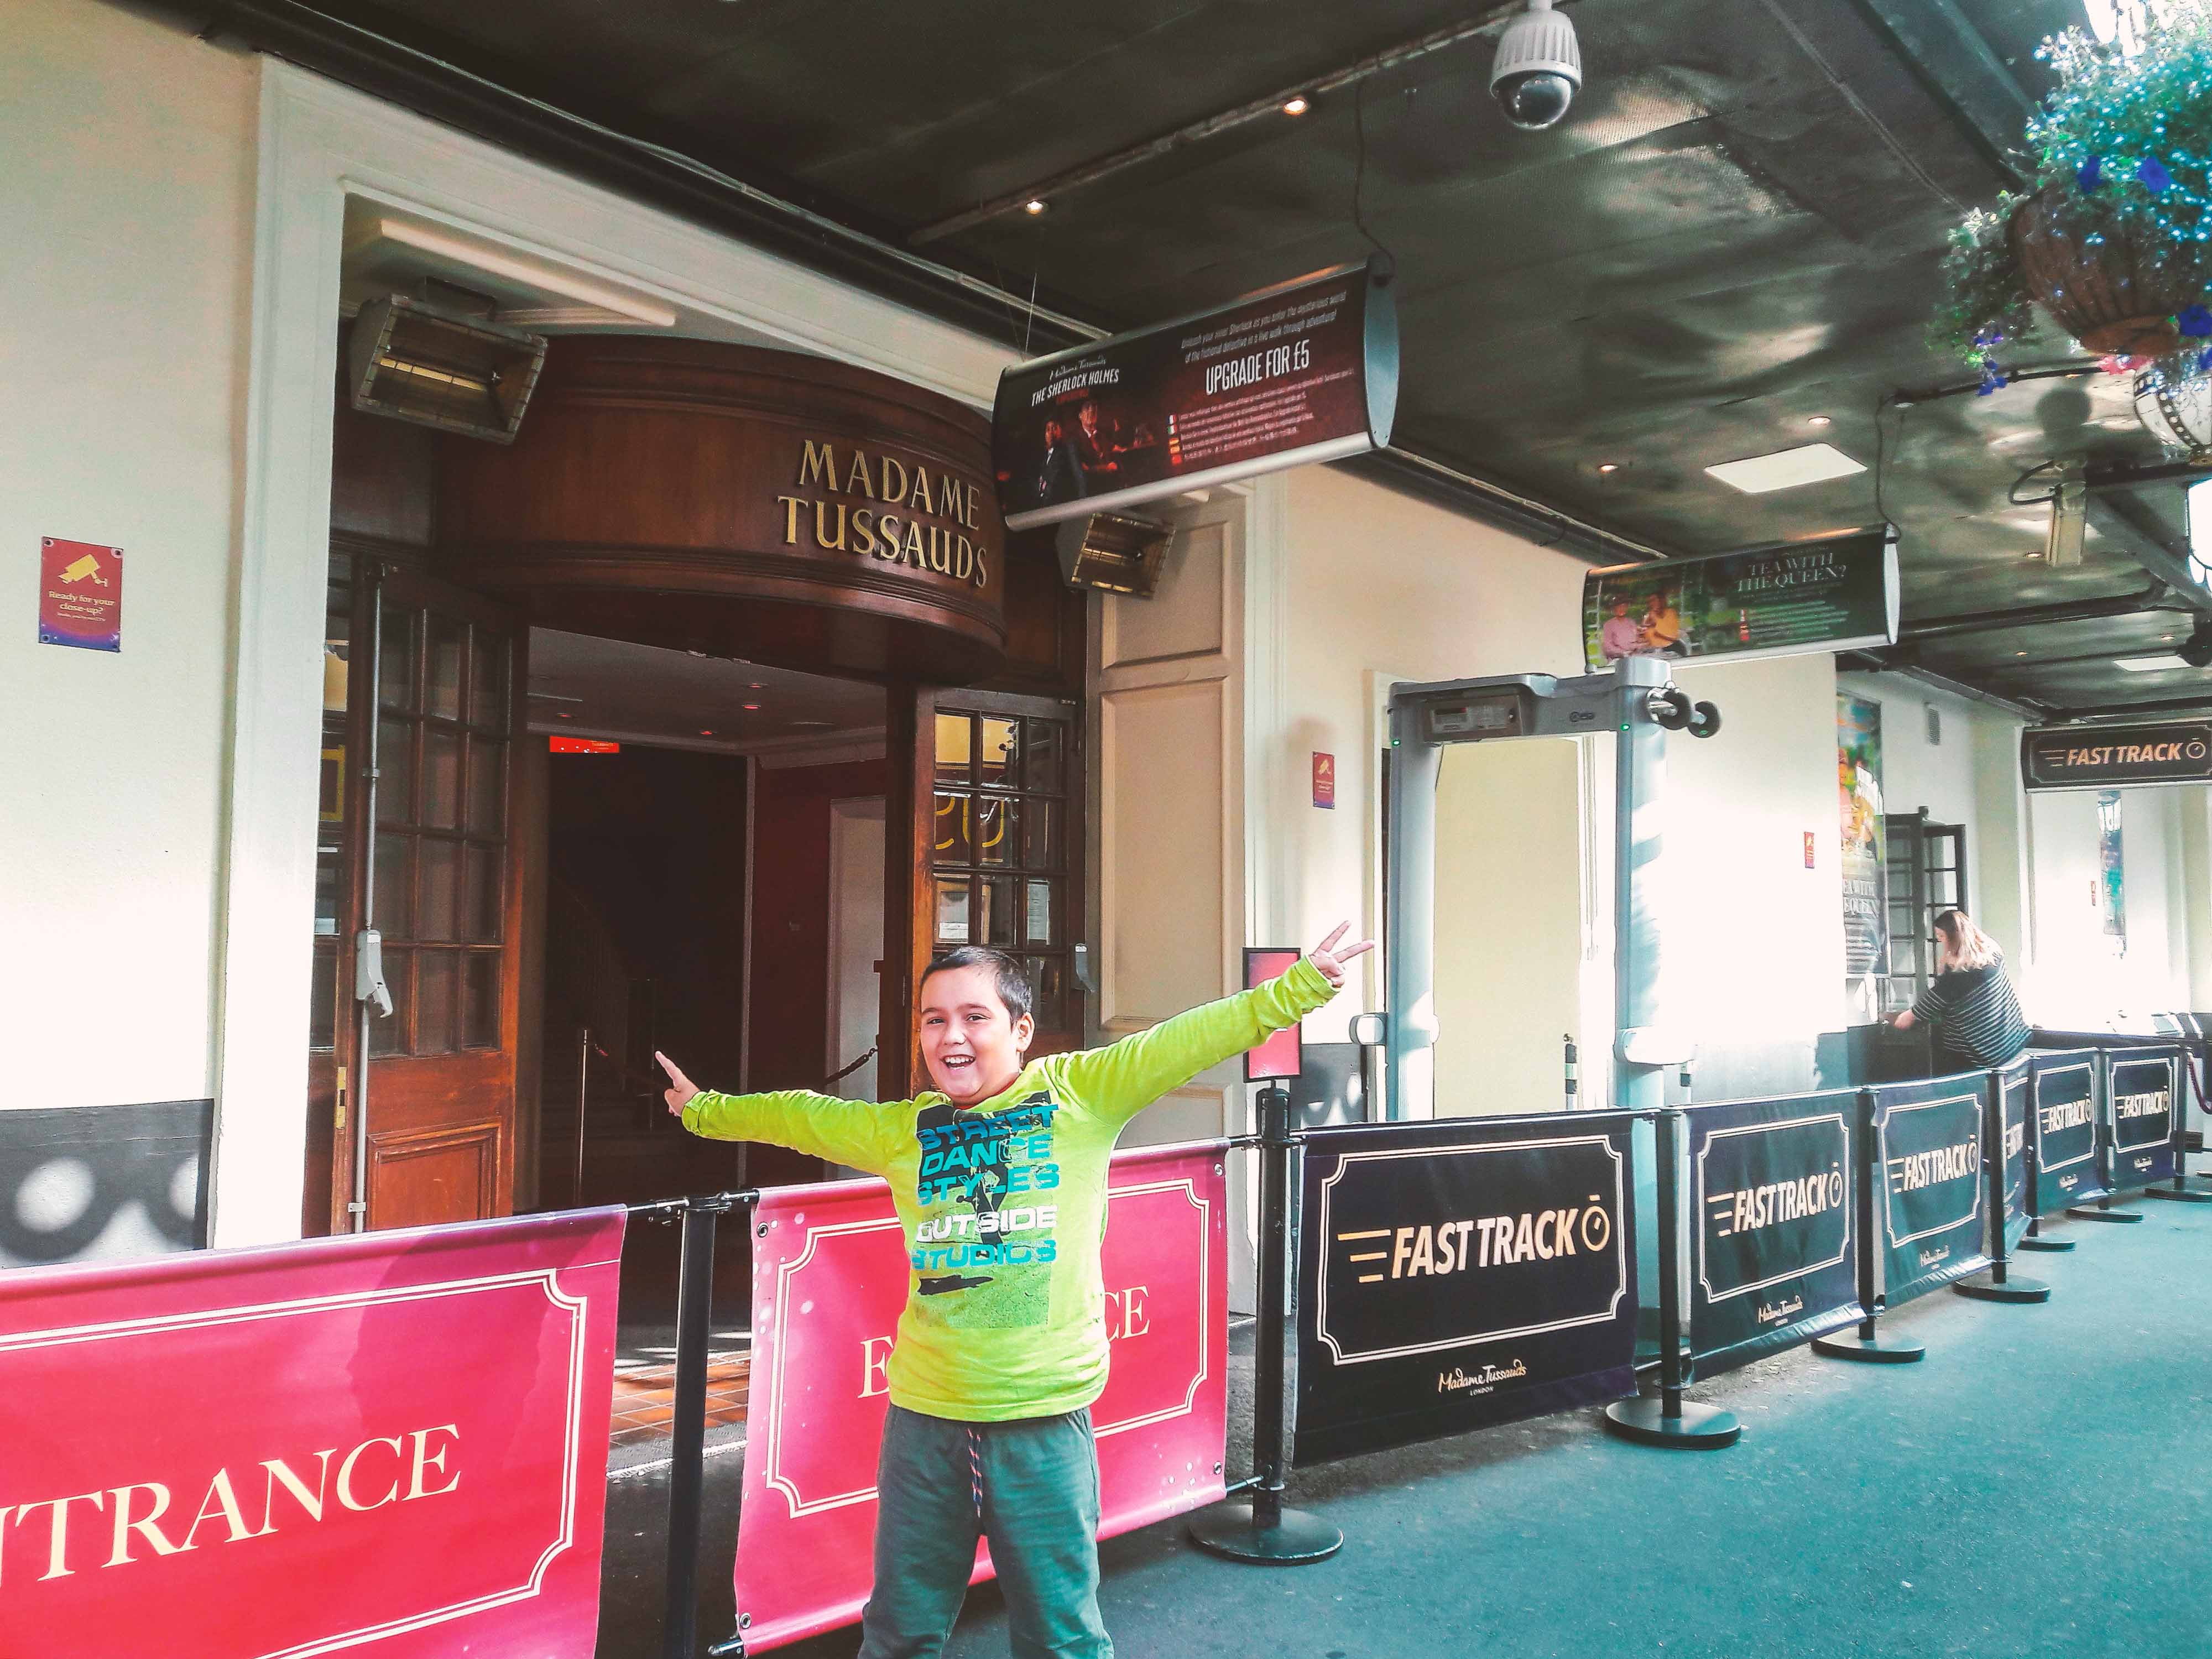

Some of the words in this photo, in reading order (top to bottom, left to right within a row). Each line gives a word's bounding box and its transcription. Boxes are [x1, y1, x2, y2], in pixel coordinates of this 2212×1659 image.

[1031, 388, 1047, 407] THE
[1047, 373, 1088, 398] SHERLOCK
[1089, 368, 1120, 385] HOLMES
[1206, 353, 1262, 396] UPGRADE
[1266, 346, 1290, 379] FOR
[1293, 339, 1310, 371] £5
[799, 439, 979, 531] MADAME
[777, 495, 987, 588] TUSSAUDS
[49, 591, 77, 602] Ready
[79, 594, 92, 603] for
[1735, 577, 1772, 591] THE
[2067, 747, 2114, 766] FAST
[2114, 742, 2184, 763] TRACK
[917, 1104, 1059, 1151] STREET
[922, 1134, 1052, 1177] DANCE
[1903, 1152, 1931, 1191] FAST
[1931, 1143, 1968, 1183] TRACK
[916, 1206, 1058, 1241] OUTSIDE
[1734, 1185, 1777, 1232] FAST
[1777, 1173, 1829, 1222] TRACK
[912, 1239, 1056, 1270] STUDIOS
[1391, 1220, 1474, 1279] FAST
[1477, 1208, 1579, 1269] TRACK
[1438, 1368, 1485, 1392] Madame
[1482, 1359, 1527, 1383] Tussauds
